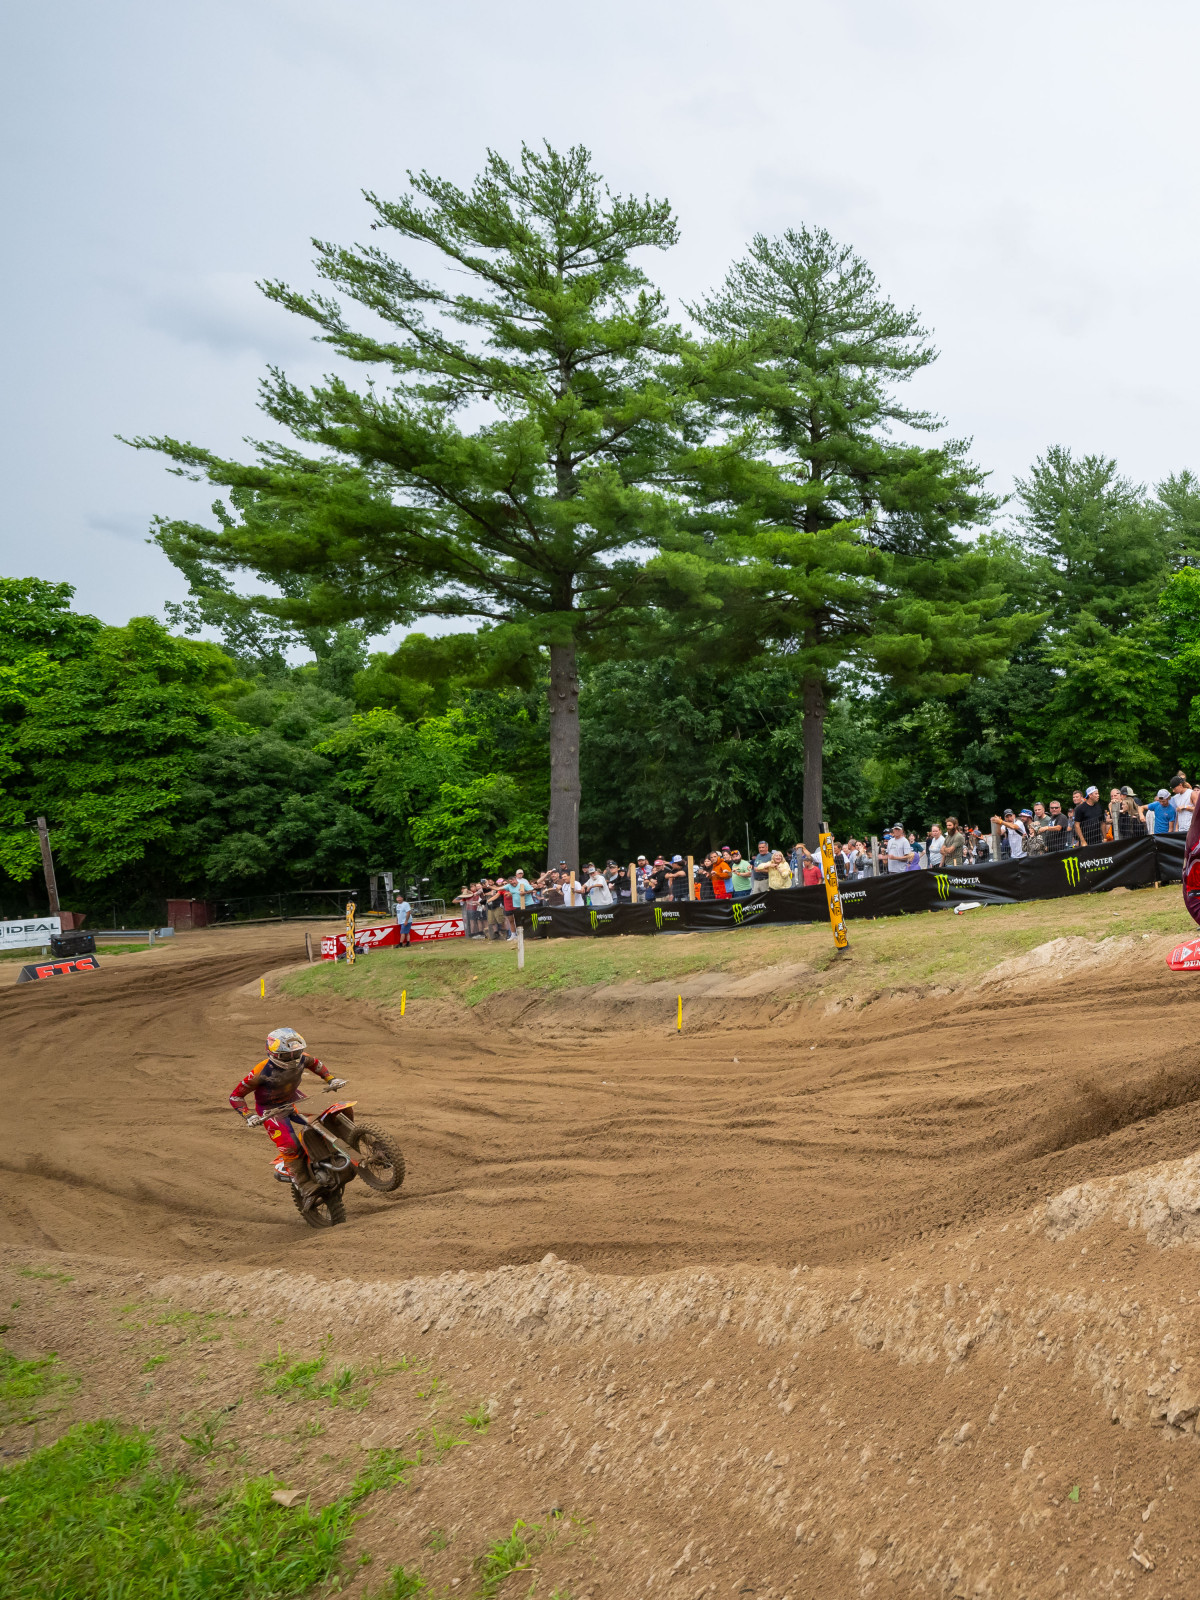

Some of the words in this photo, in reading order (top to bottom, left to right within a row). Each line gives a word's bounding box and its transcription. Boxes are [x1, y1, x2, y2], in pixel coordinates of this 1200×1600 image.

[1080, 856, 1113, 869] MONSTER
[949, 876, 980, 886] MONSTER
[7, 923, 59, 934] IDEAL
